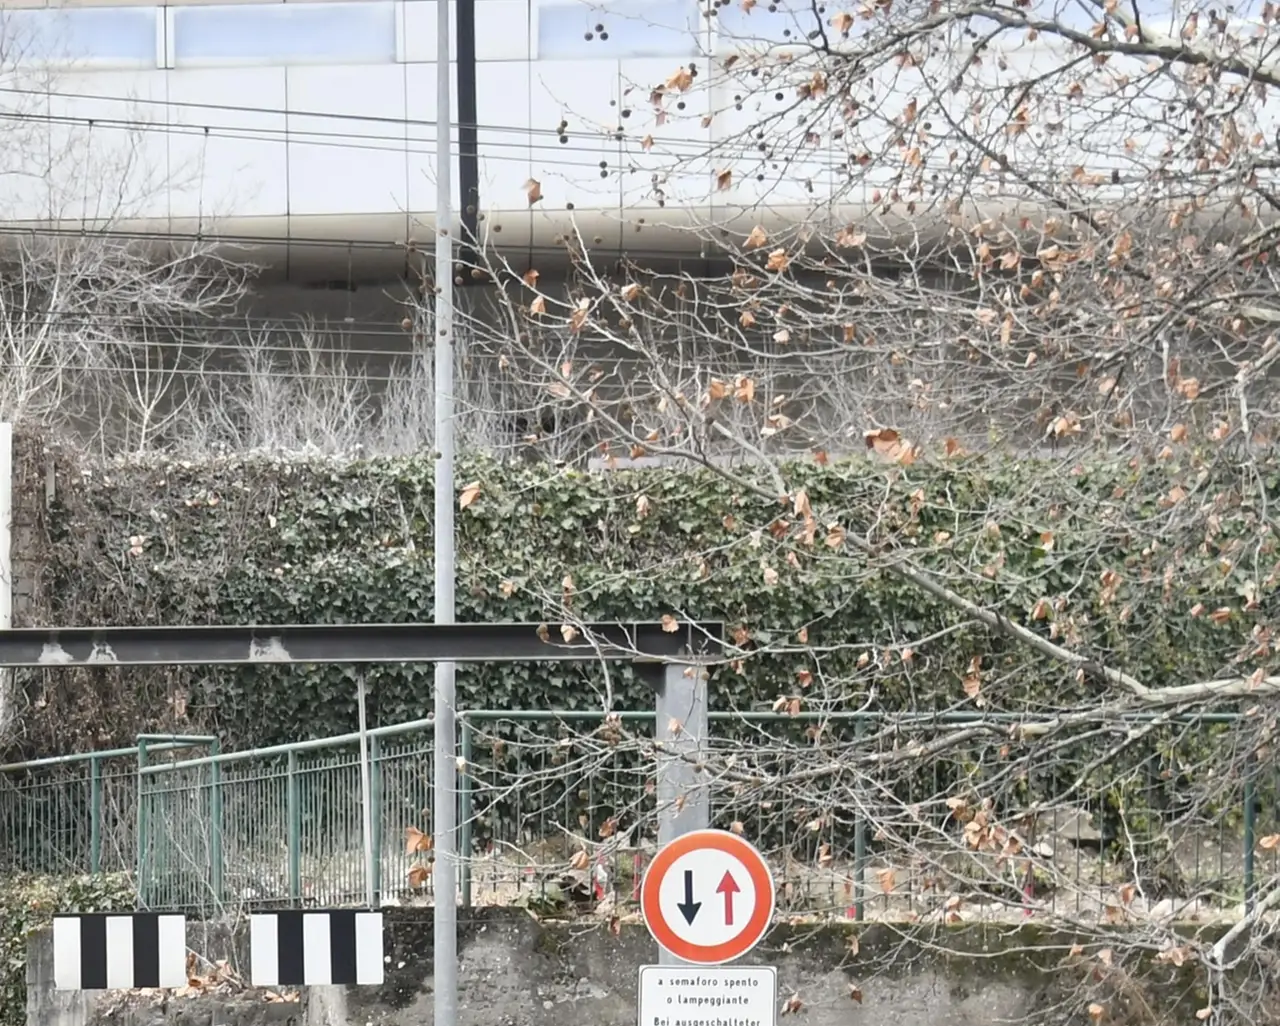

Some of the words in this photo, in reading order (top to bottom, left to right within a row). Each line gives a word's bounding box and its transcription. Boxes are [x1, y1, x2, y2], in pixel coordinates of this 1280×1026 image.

[670, 976, 718, 986] semaforo
[724, 977, 759, 988] spento
[678, 994, 749, 1007] lampeggiante
[653, 1016, 670, 1026] Bei
